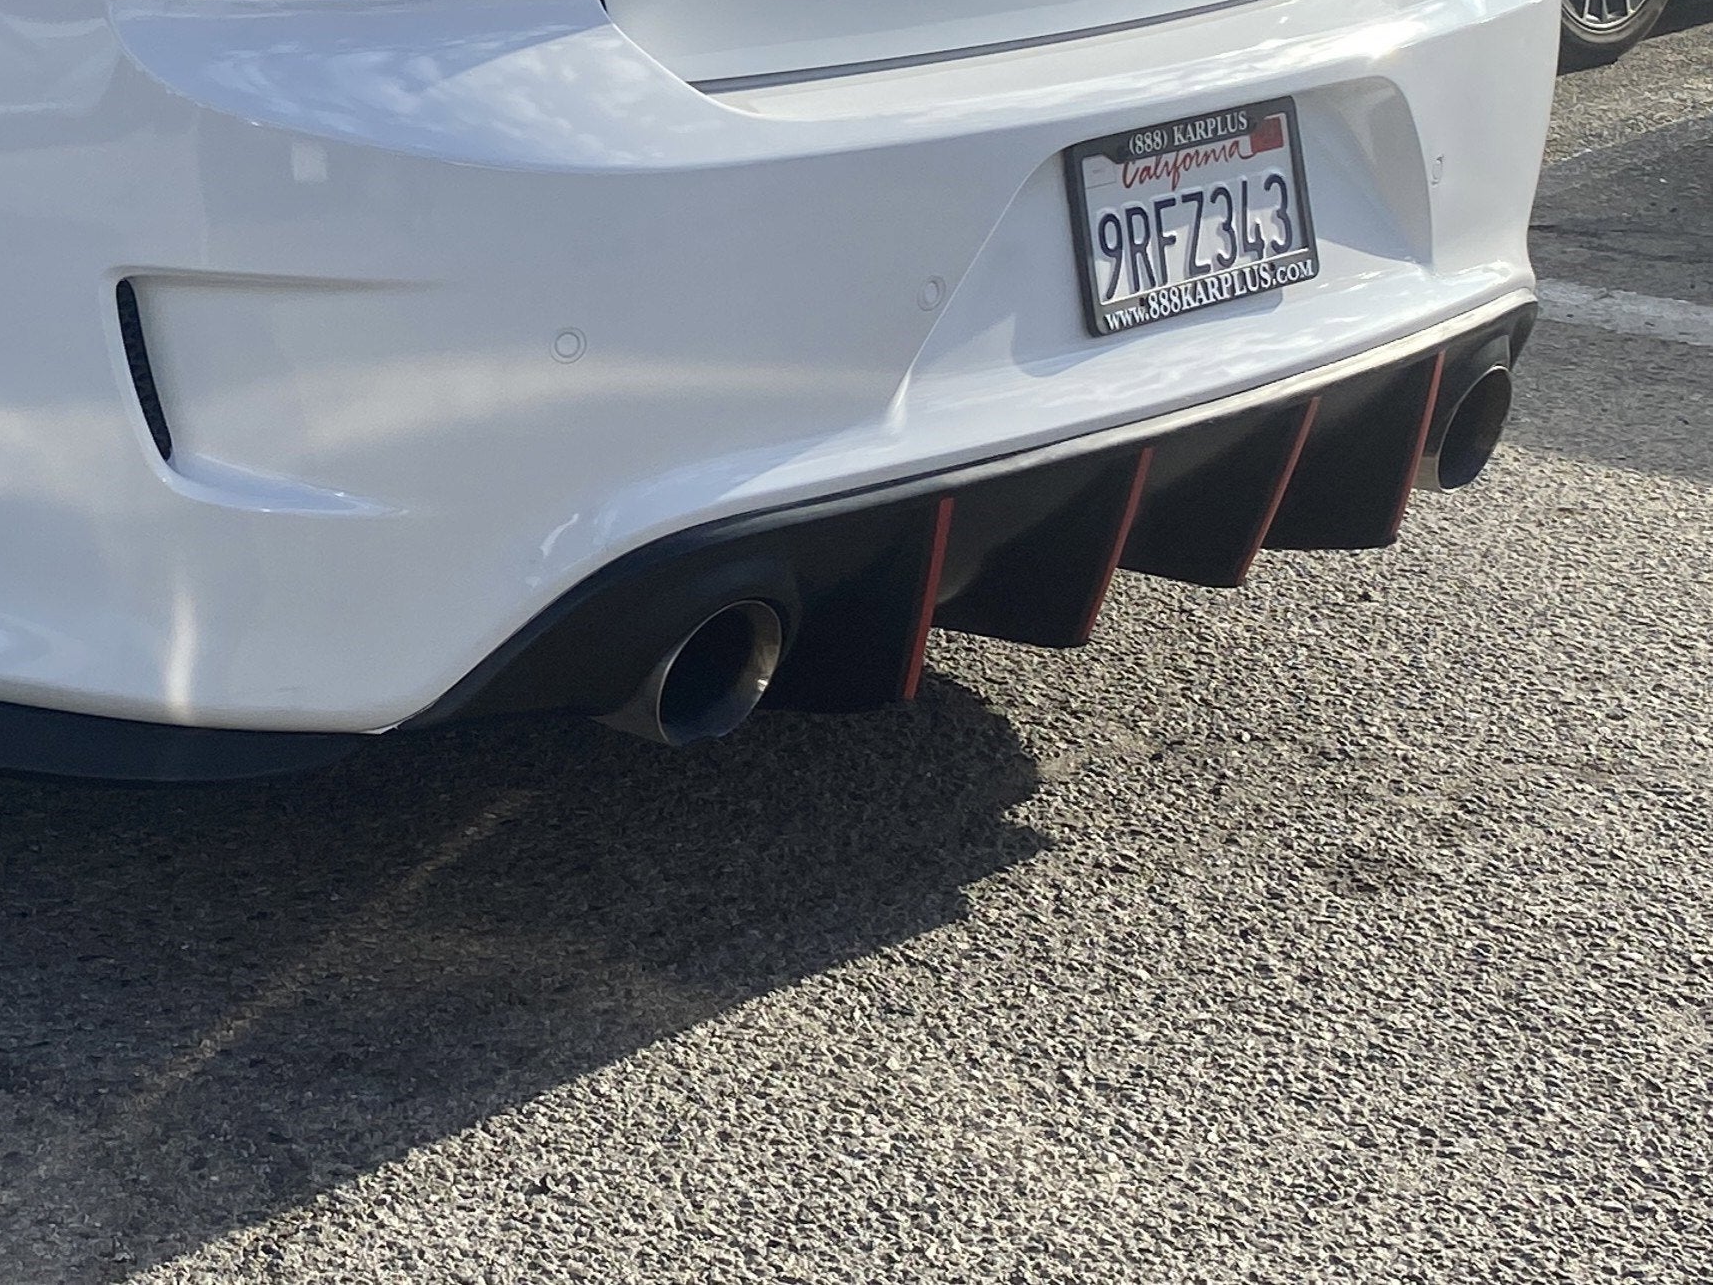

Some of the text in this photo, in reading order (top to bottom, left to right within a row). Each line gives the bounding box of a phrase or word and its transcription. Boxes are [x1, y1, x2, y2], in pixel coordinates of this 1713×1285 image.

[1129, 111, 1249, 155] (888) KARPLUS
[1121, 139, 1258, 190] California
[1098, 173, 1293, 301] 9RFZ343
